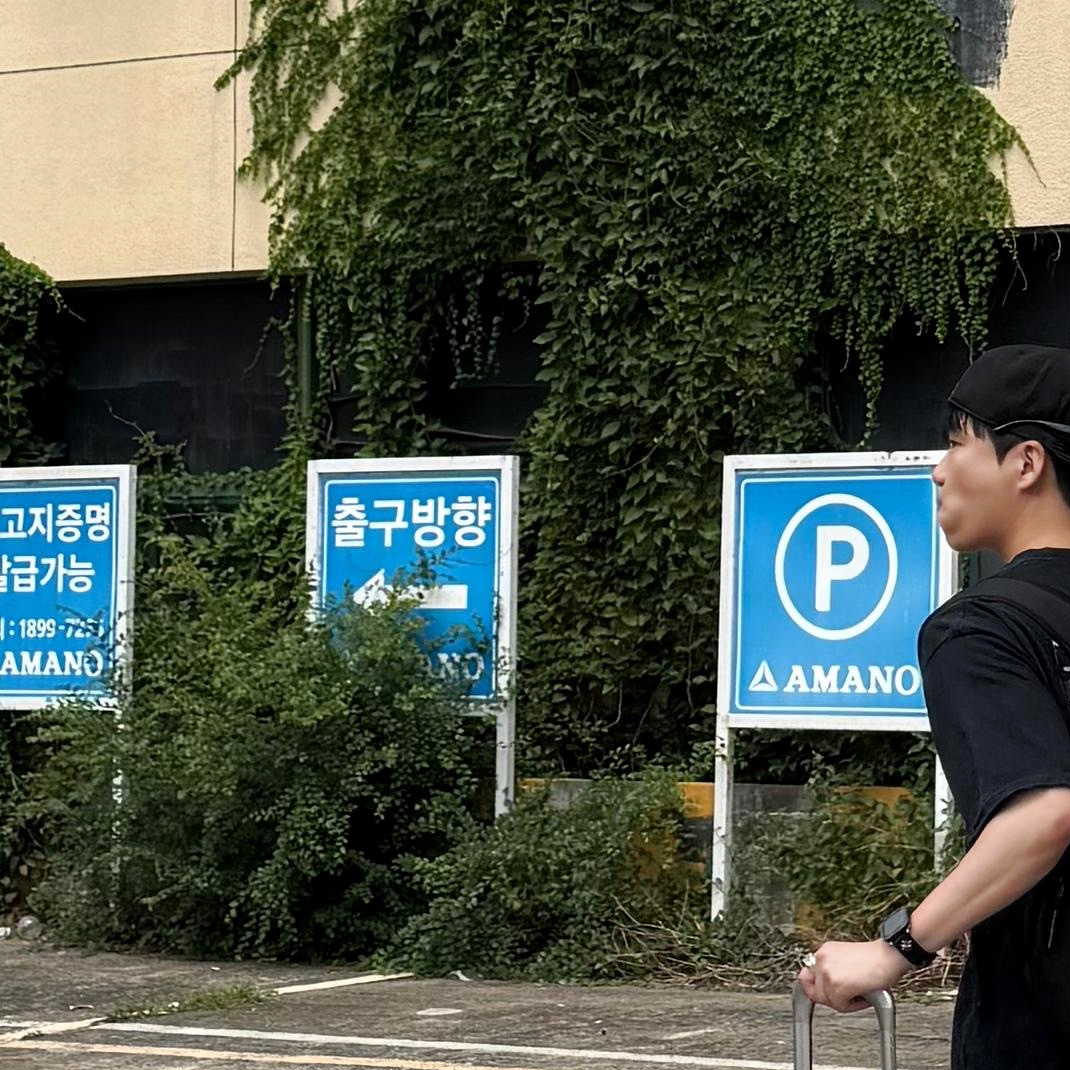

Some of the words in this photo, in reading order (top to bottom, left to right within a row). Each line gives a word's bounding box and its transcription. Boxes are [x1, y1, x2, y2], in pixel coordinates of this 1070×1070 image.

[0, 502, 110, 543] 고지증명
[331, 496, 492, 548] 출구방향
[814, 525, 870, 612] P
[0, 650, 104, 677] AMANO
[783, 664, 921, 696] AMANO
